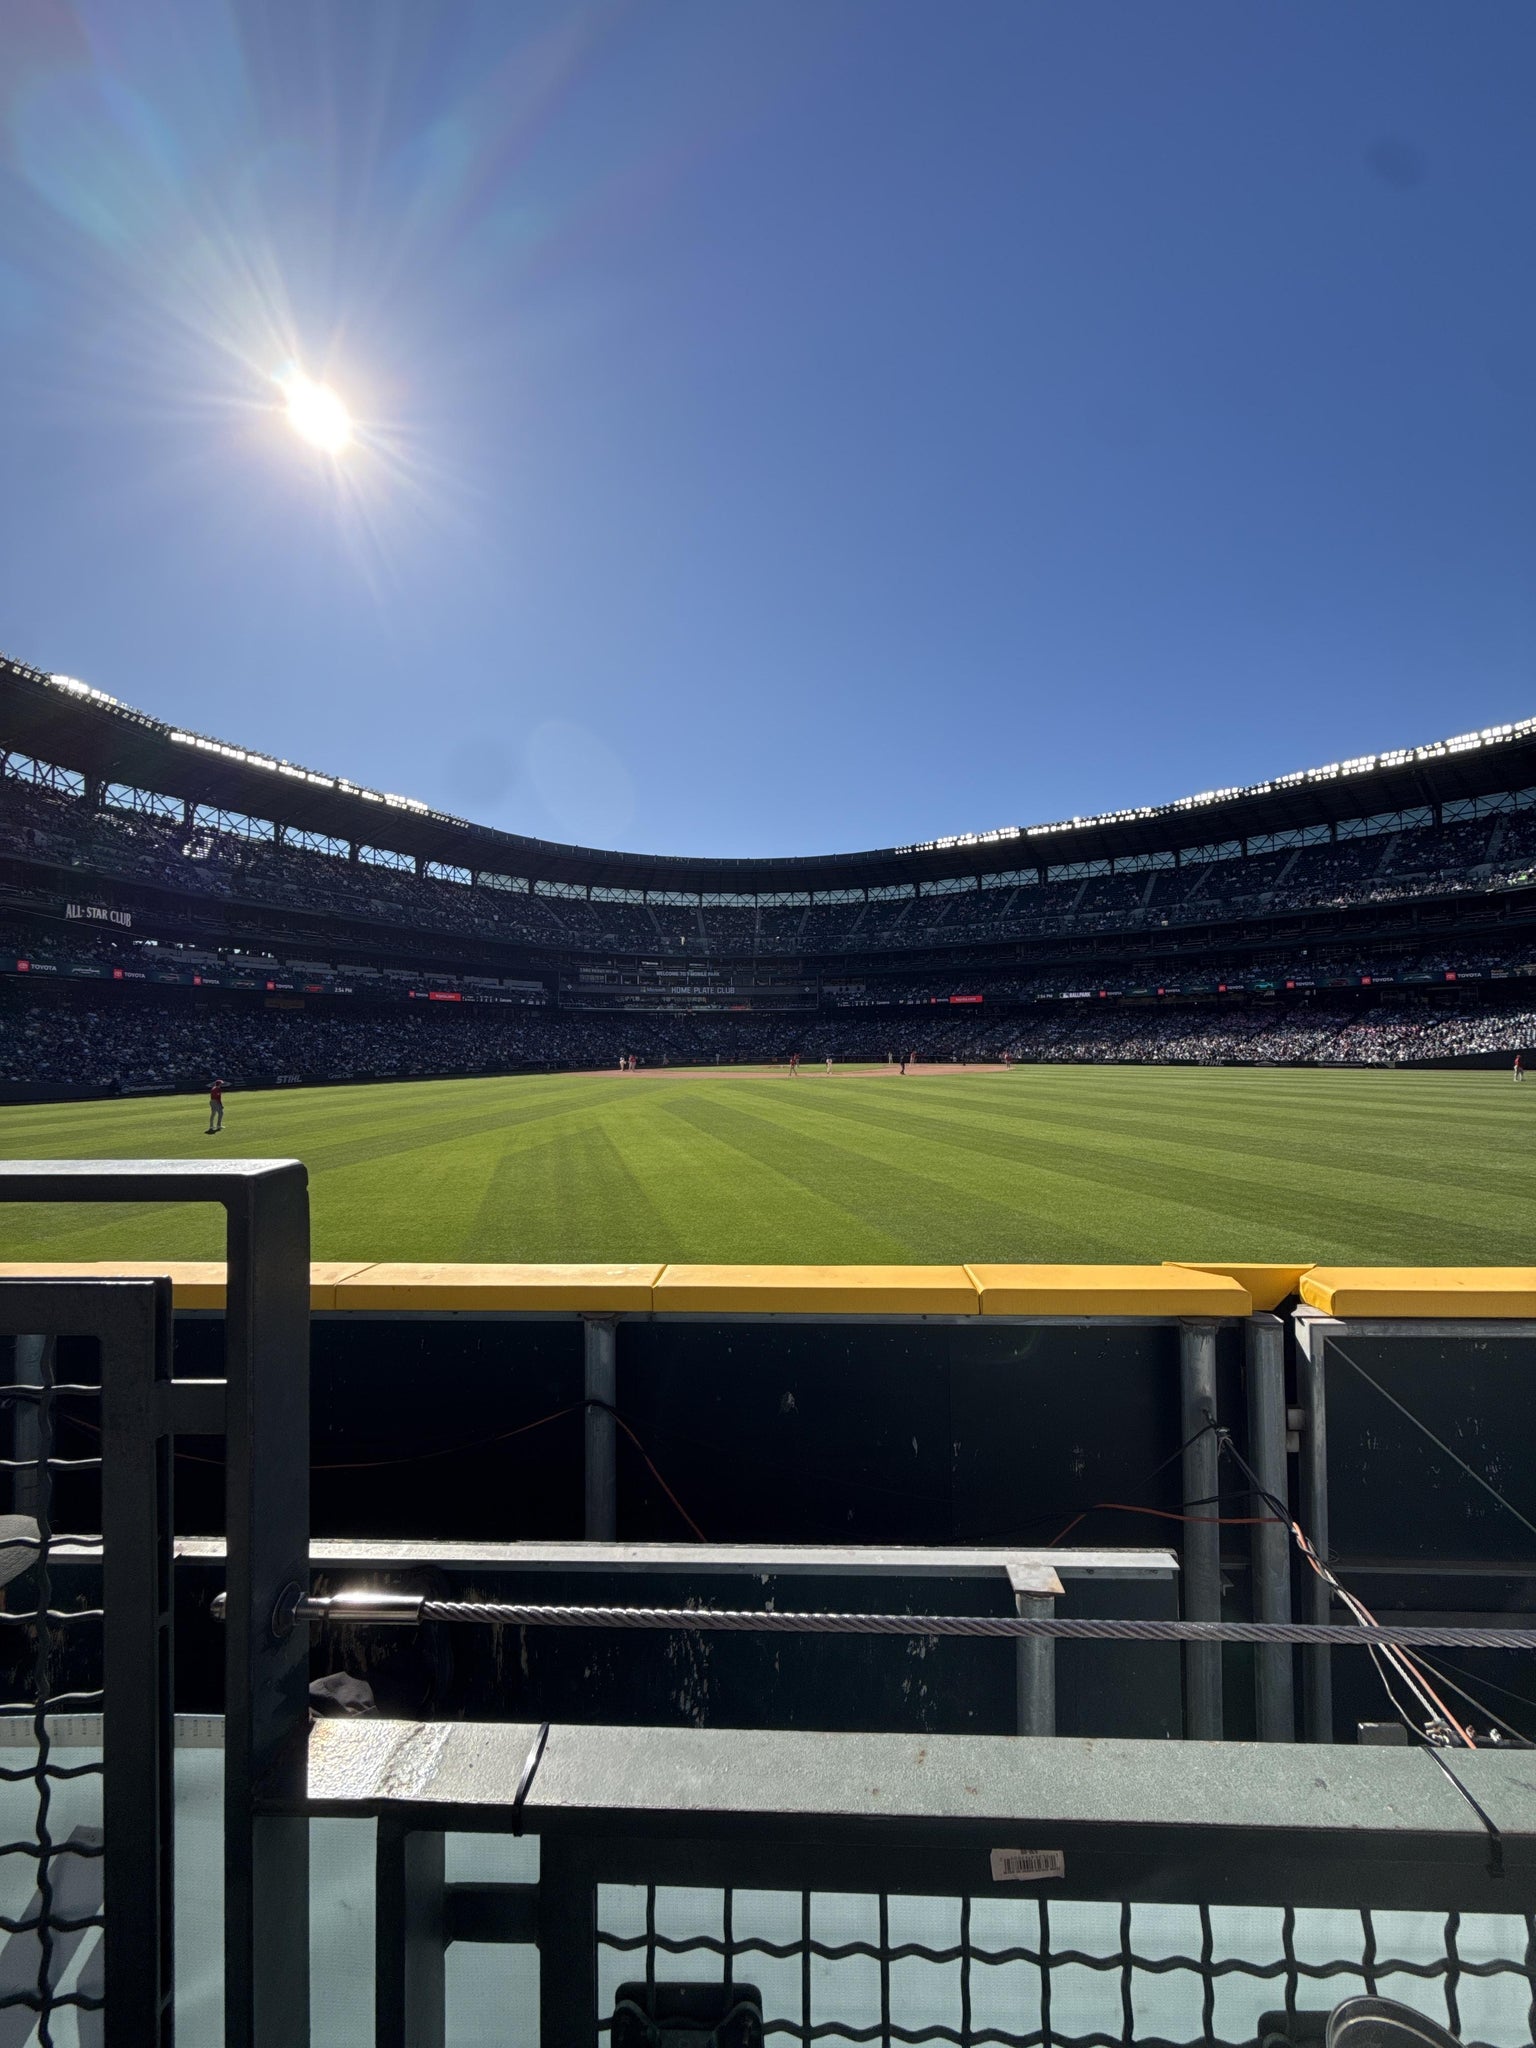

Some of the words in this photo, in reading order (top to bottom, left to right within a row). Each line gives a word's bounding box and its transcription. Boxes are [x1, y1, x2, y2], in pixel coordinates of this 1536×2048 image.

[109, 910, 132, 928] CLUB
[30, 963, 57, 972] TOYOTA
[124, 971, 146, 979] TOYOTA
[671, 986, 691, 995] HOME
[693, 986, 715, 995] PLATE
[716, 986, 735, 994] CLUB
[1198, 1059, 1224, 1067] STIHL
[275, 1074, 302, 1084] STIHL
